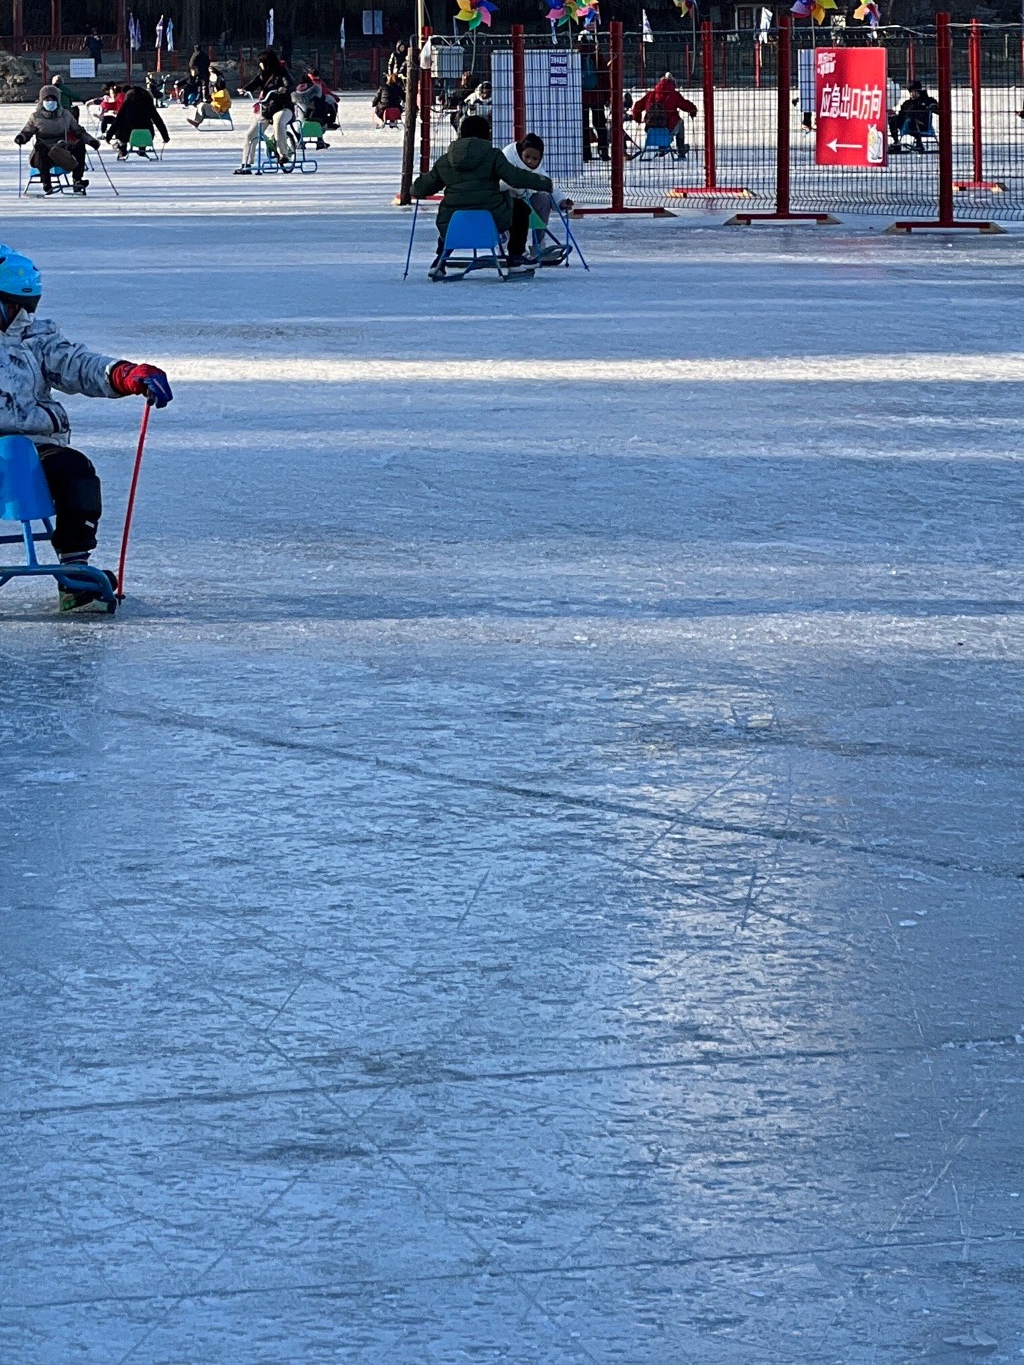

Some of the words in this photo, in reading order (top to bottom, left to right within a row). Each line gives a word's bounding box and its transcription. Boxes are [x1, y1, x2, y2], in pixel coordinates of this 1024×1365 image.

[820, 83, 883, 120] 应急出口方向
